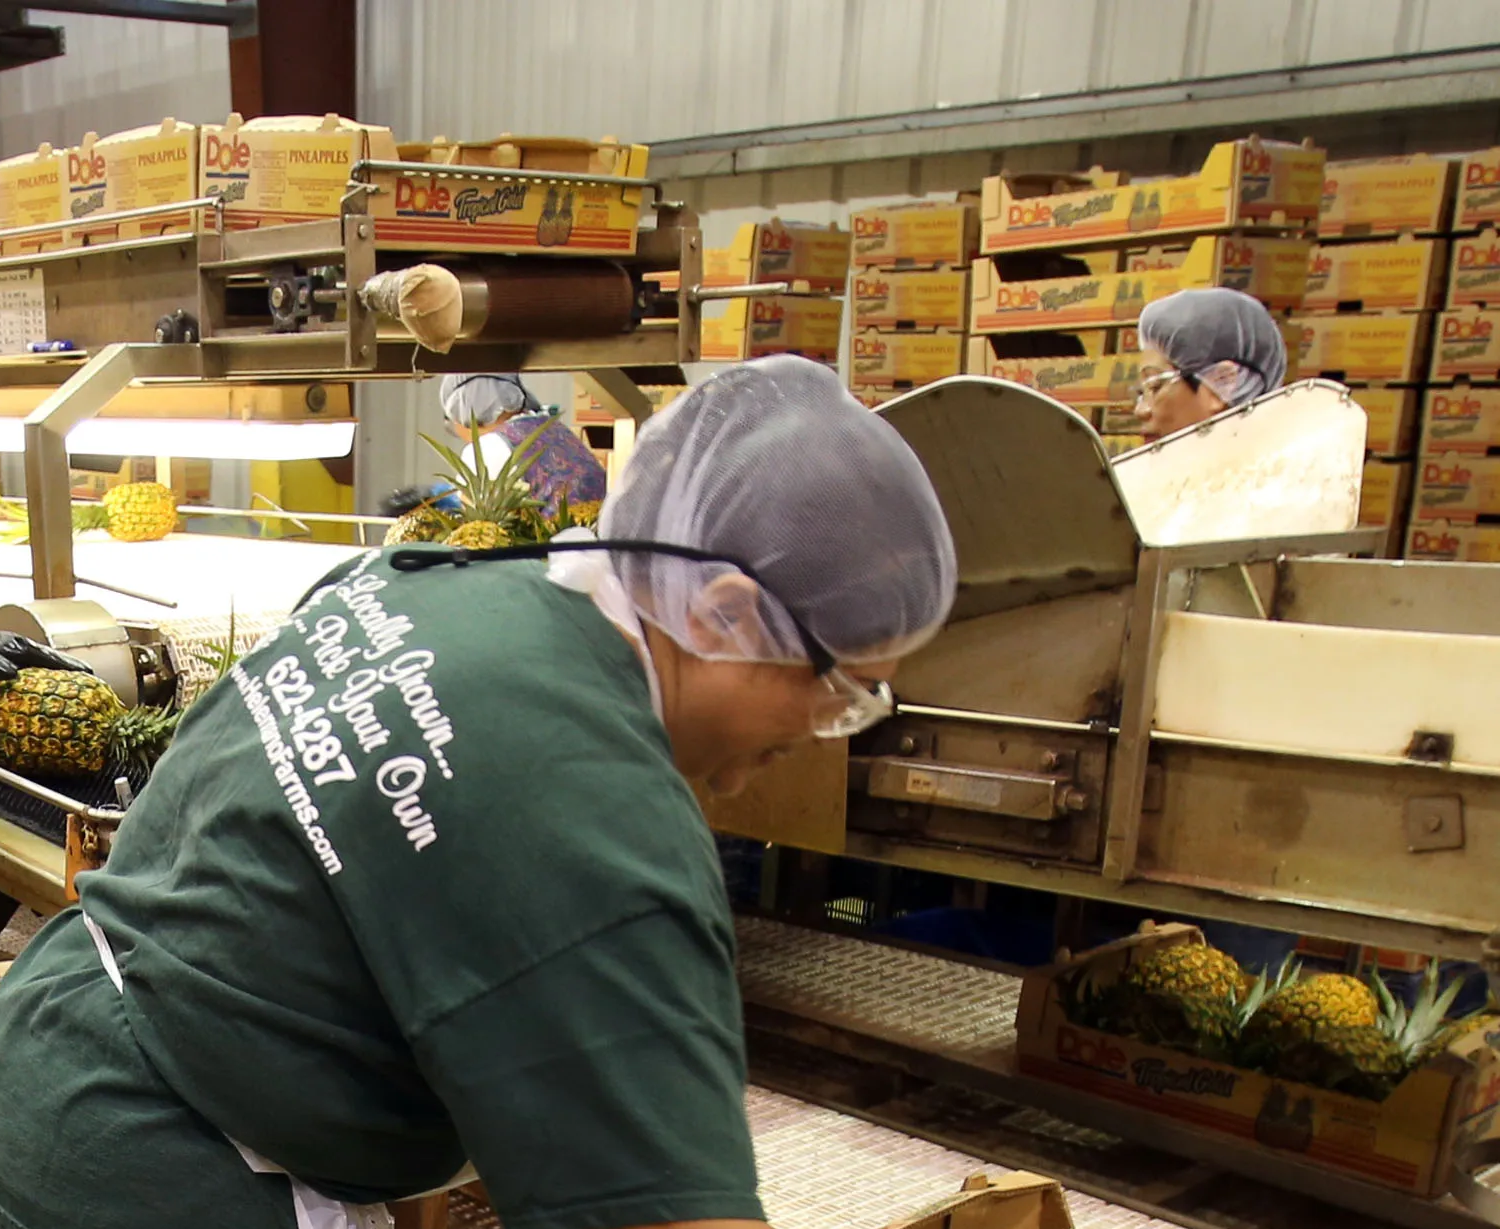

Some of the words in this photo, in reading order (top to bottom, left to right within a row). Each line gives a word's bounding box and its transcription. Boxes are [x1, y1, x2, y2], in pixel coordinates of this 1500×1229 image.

[137, 146, 188, 167] PINEAPPLES
[205, 134, 251, 171] Dole
[289, 149, 350, 165] PINEAPPLES
[68, 148, 106, 185] Dole
[395, 176, 450, 212] Dole
[1007, 202, 1052, 226] Dole
[997, 286, 1041, 309] Dole
[1443, 317, 1493, 339] Dole
[1432, 395, 1481, 416] Dole
[328, 668, 393, 754] Your
[376, 755, 438, 852] Own
